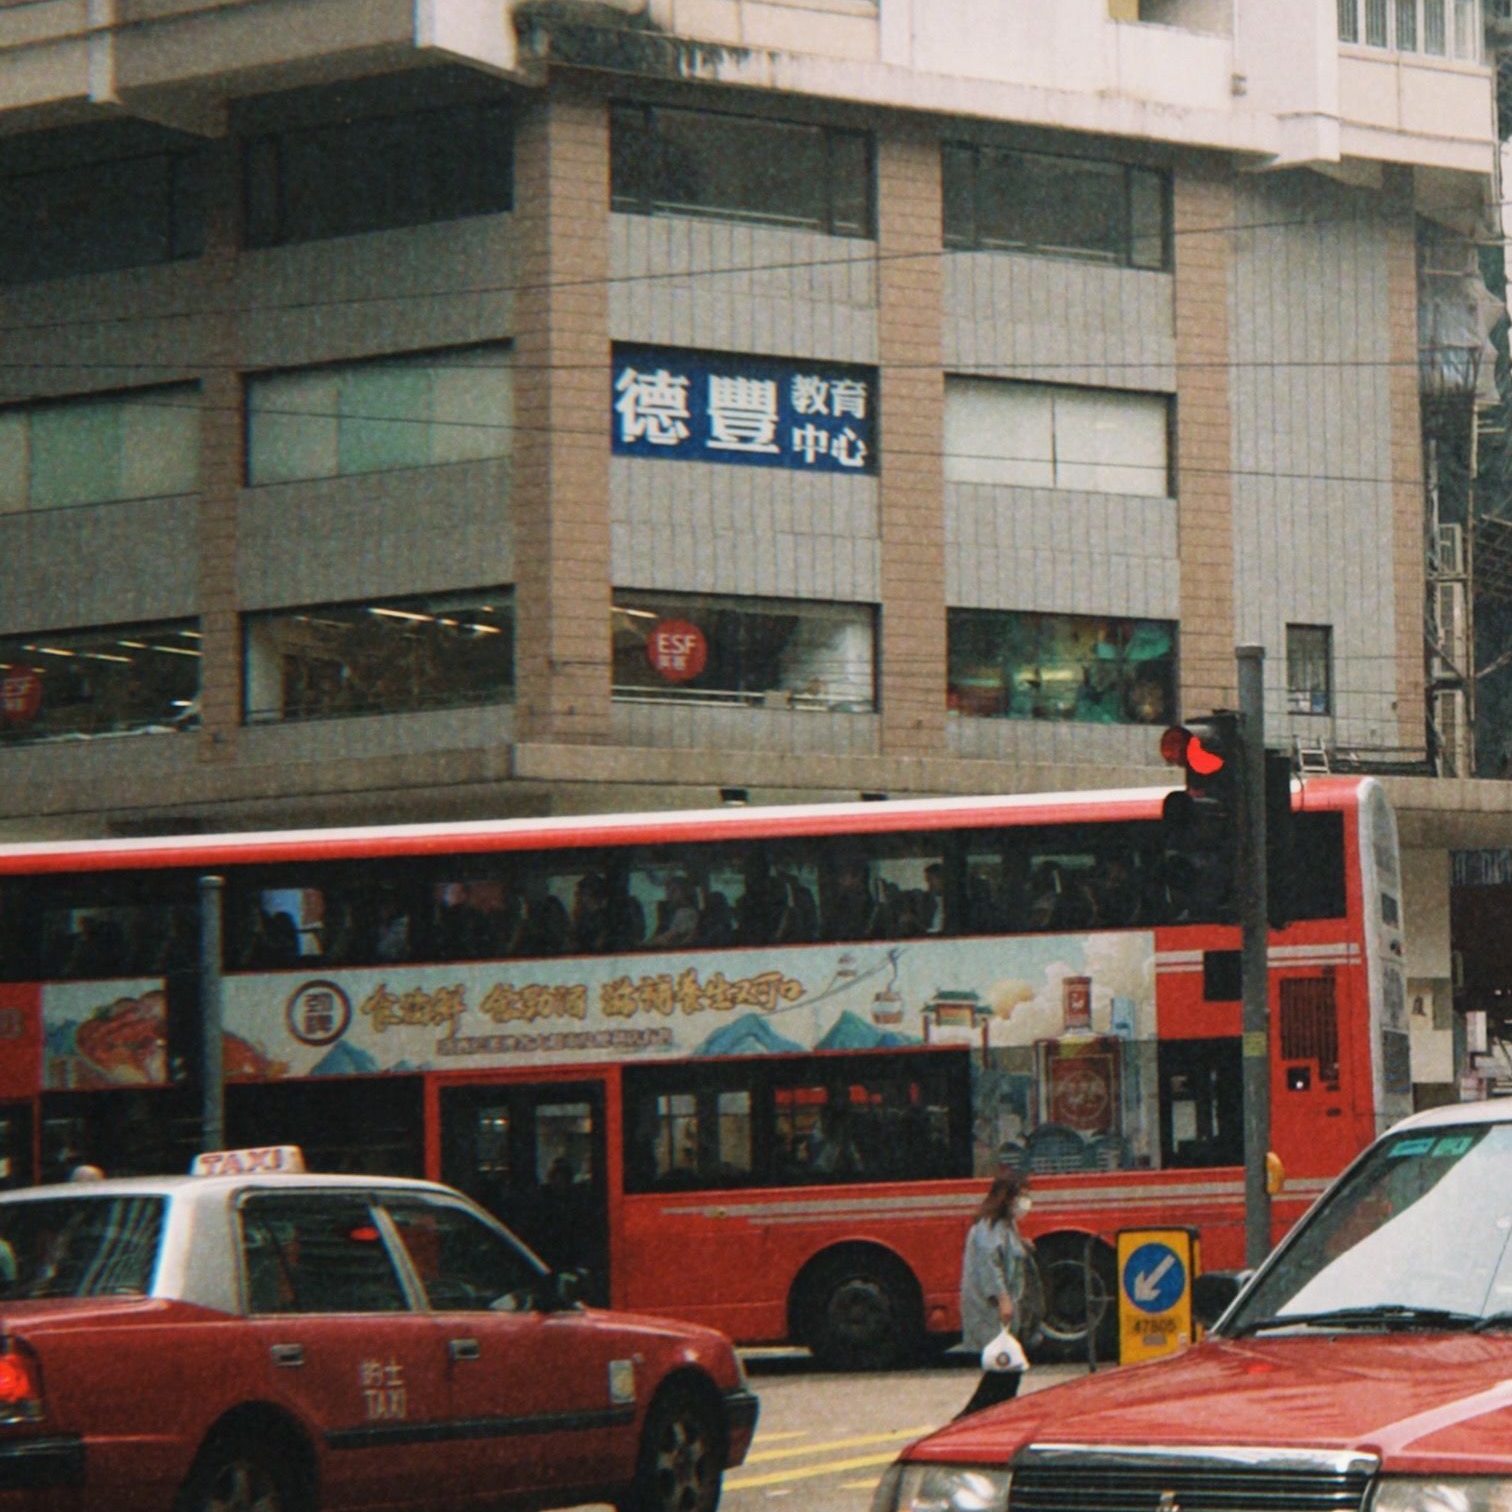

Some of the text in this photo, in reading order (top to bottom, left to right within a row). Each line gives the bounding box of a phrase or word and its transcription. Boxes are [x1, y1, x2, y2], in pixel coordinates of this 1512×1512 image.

[614, 367, 781, 454] 德豐
[790, 374, 868, 420] 教育
[791, 422, 868, 467] 中心
[657, 632, 697, 655] ESF
[200, 1148, 283, 1175] TAXI
